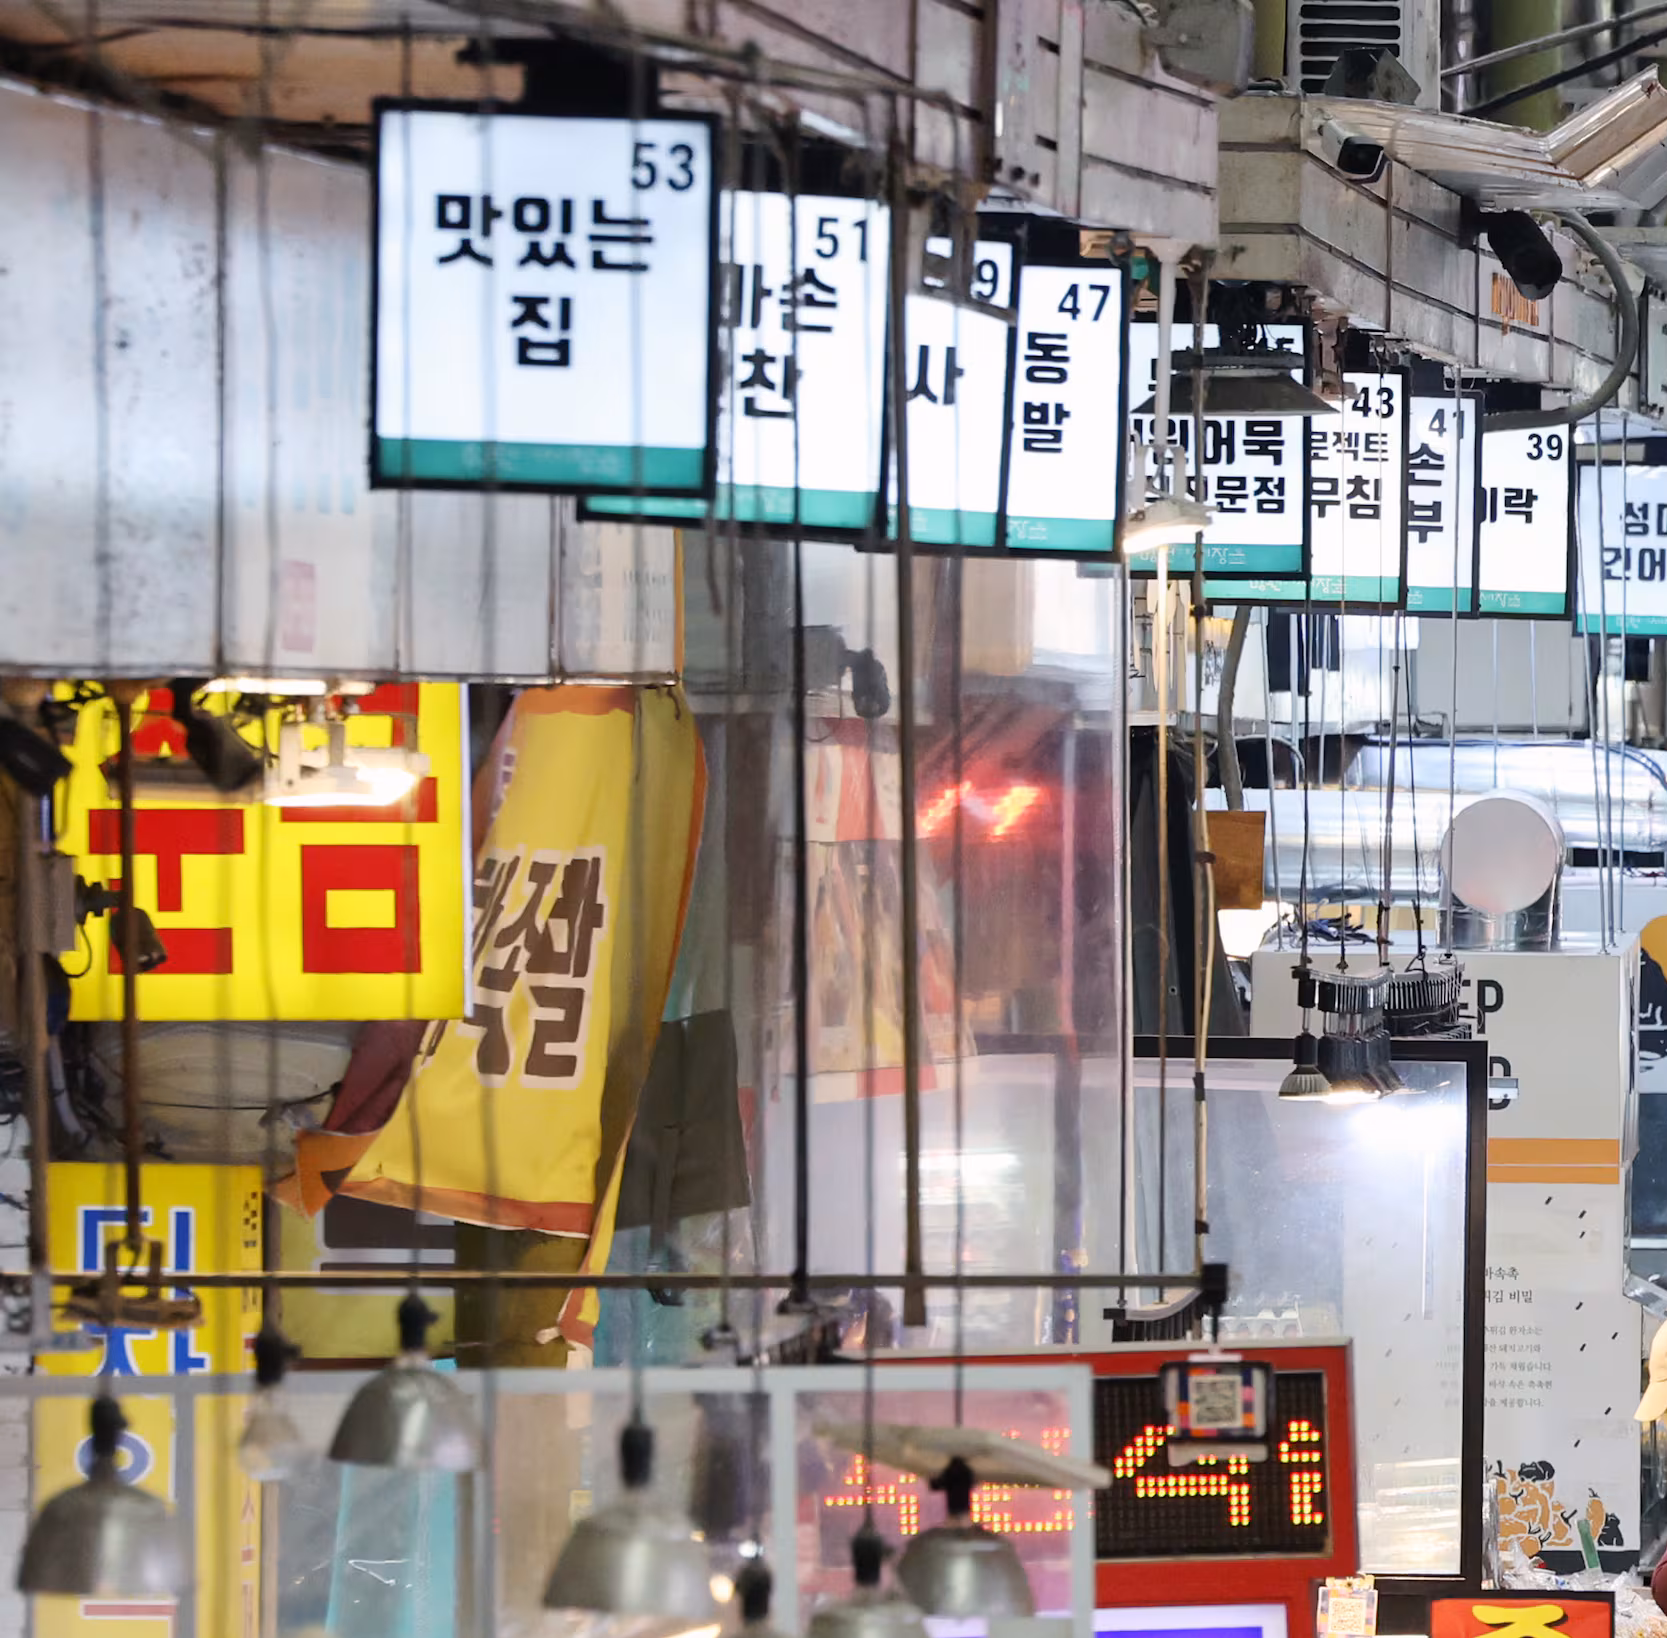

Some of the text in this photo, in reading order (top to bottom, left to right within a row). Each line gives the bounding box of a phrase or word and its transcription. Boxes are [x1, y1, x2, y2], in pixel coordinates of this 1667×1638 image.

[631, 142, 697, 192] 53
[436, 193, 655, 271] 맛있는
[814, 217, 868, 262] 51
[1057, 284, 1110, 322] 47
[511, 295, 571, 367] 집
[1024, 332, 1070, 384] 동
[1351, 386, 1395, 419] 43
[1428, 407, 1466, 441] 41
[1023, 402, 1071, 454] 발
[1526, 432, 1564, 462] 39
[1311, 474, 1384, 521] 무침
[1509, 1289, 1534, 1305] 비밀
